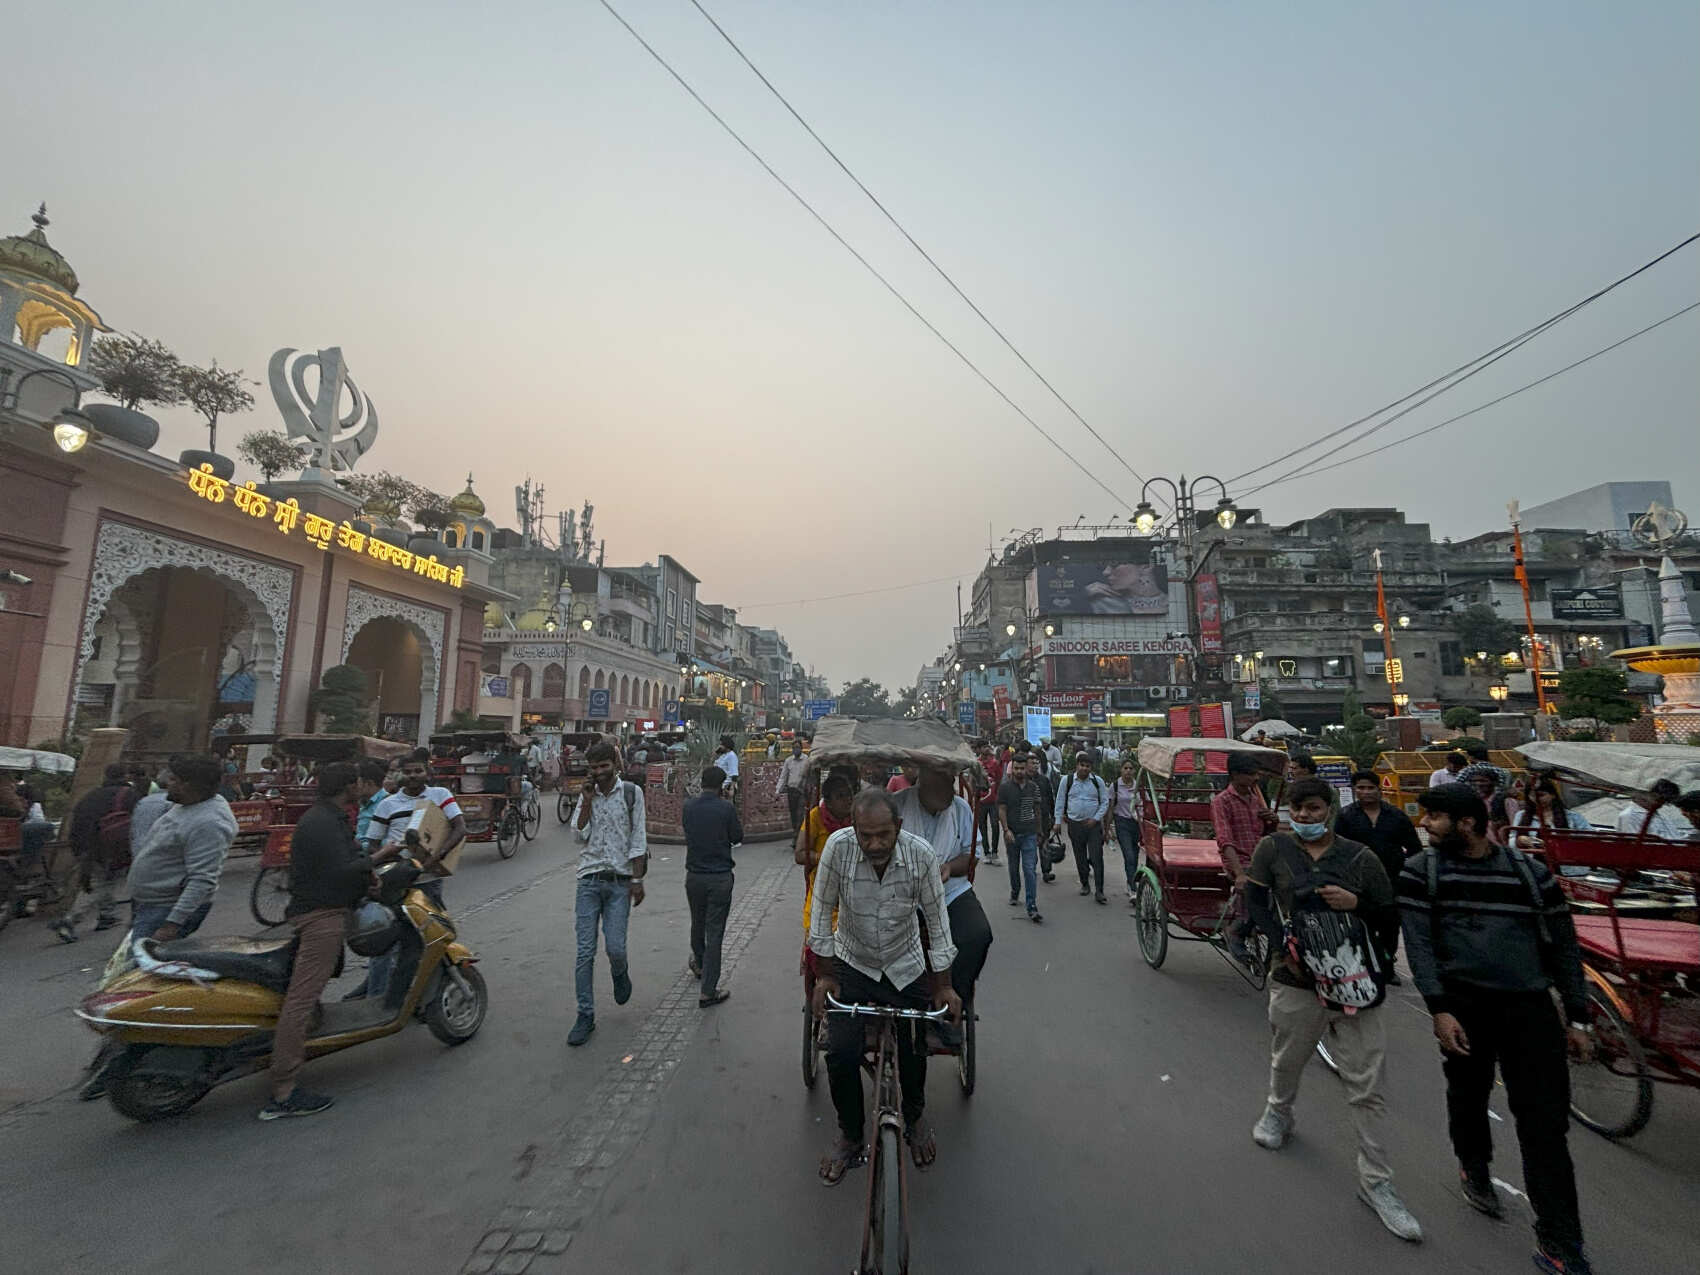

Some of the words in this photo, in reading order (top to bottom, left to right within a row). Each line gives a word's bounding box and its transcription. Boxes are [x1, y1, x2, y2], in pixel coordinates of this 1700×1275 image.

[304, 512, 335, 550] ਗੁਰੂ
[337, 520, 366, 553] ਤੇਗ
[450, 565, 464, 588] ਜੀ
[1049, 641, 1099, 653] SINDOOR
[1102, 641, 1140, 653] SAREE
[1142, 640, 1189, 653] KENDRA
[1041, 694, 1084, 704] Sindoor
